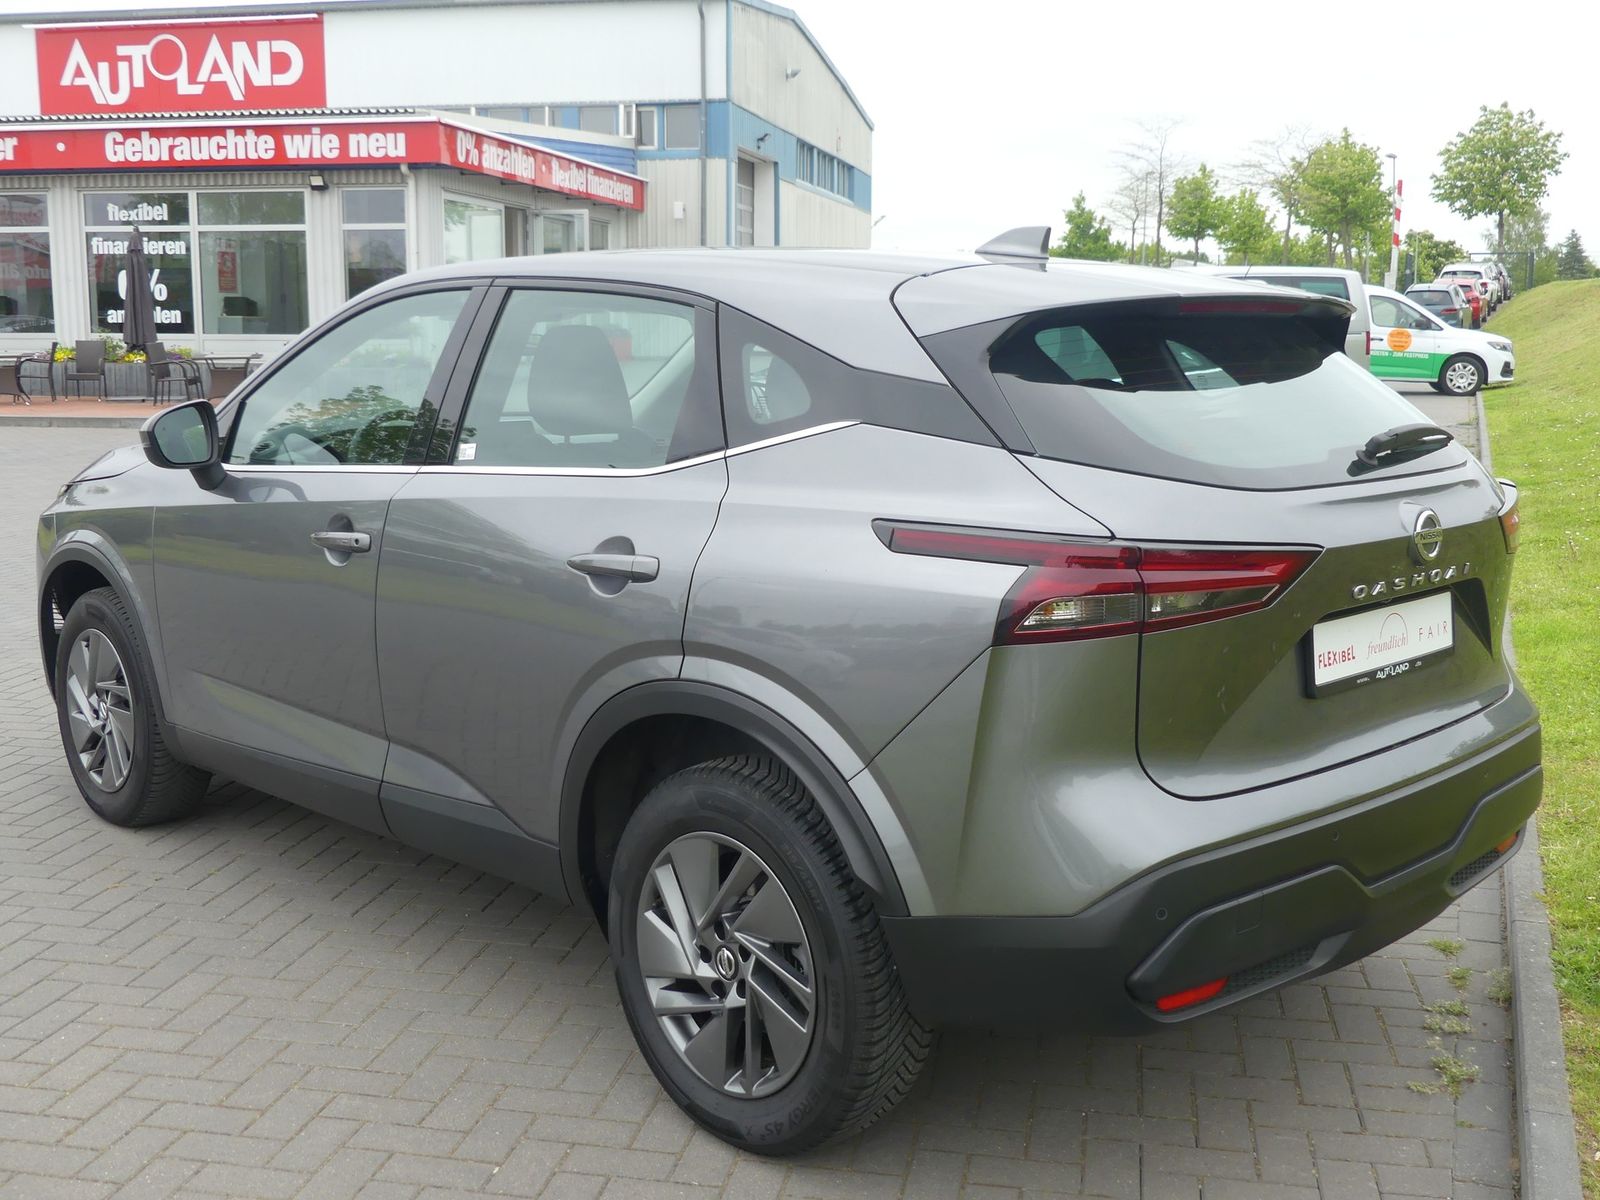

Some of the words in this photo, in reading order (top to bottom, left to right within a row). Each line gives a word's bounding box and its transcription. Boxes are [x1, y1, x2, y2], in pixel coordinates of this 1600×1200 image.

[60, 33, 304, 106] AUTOLAND
[105, 129, 275, 163] Gebrauchte
[284, 127, 339, 159] wie
[349, 132, 407, 158] neu
[456, 130, 480, 167] 0%
[482, 142, 536, 180] anzahlen
[551, 157, 587, 193] flexibel
[587, 168, 634, 205] finanzieren
[107, 202, 169, 221] flexibel
[91, 236, 187, 255] finaieren
[107, 306, 182, 324] anlen
[1318, 645, 1356, 669] FLEXIBEL
[1366, 633, 1409, 659] freundlich
[1418, 620, 1448, 641] FAIR
